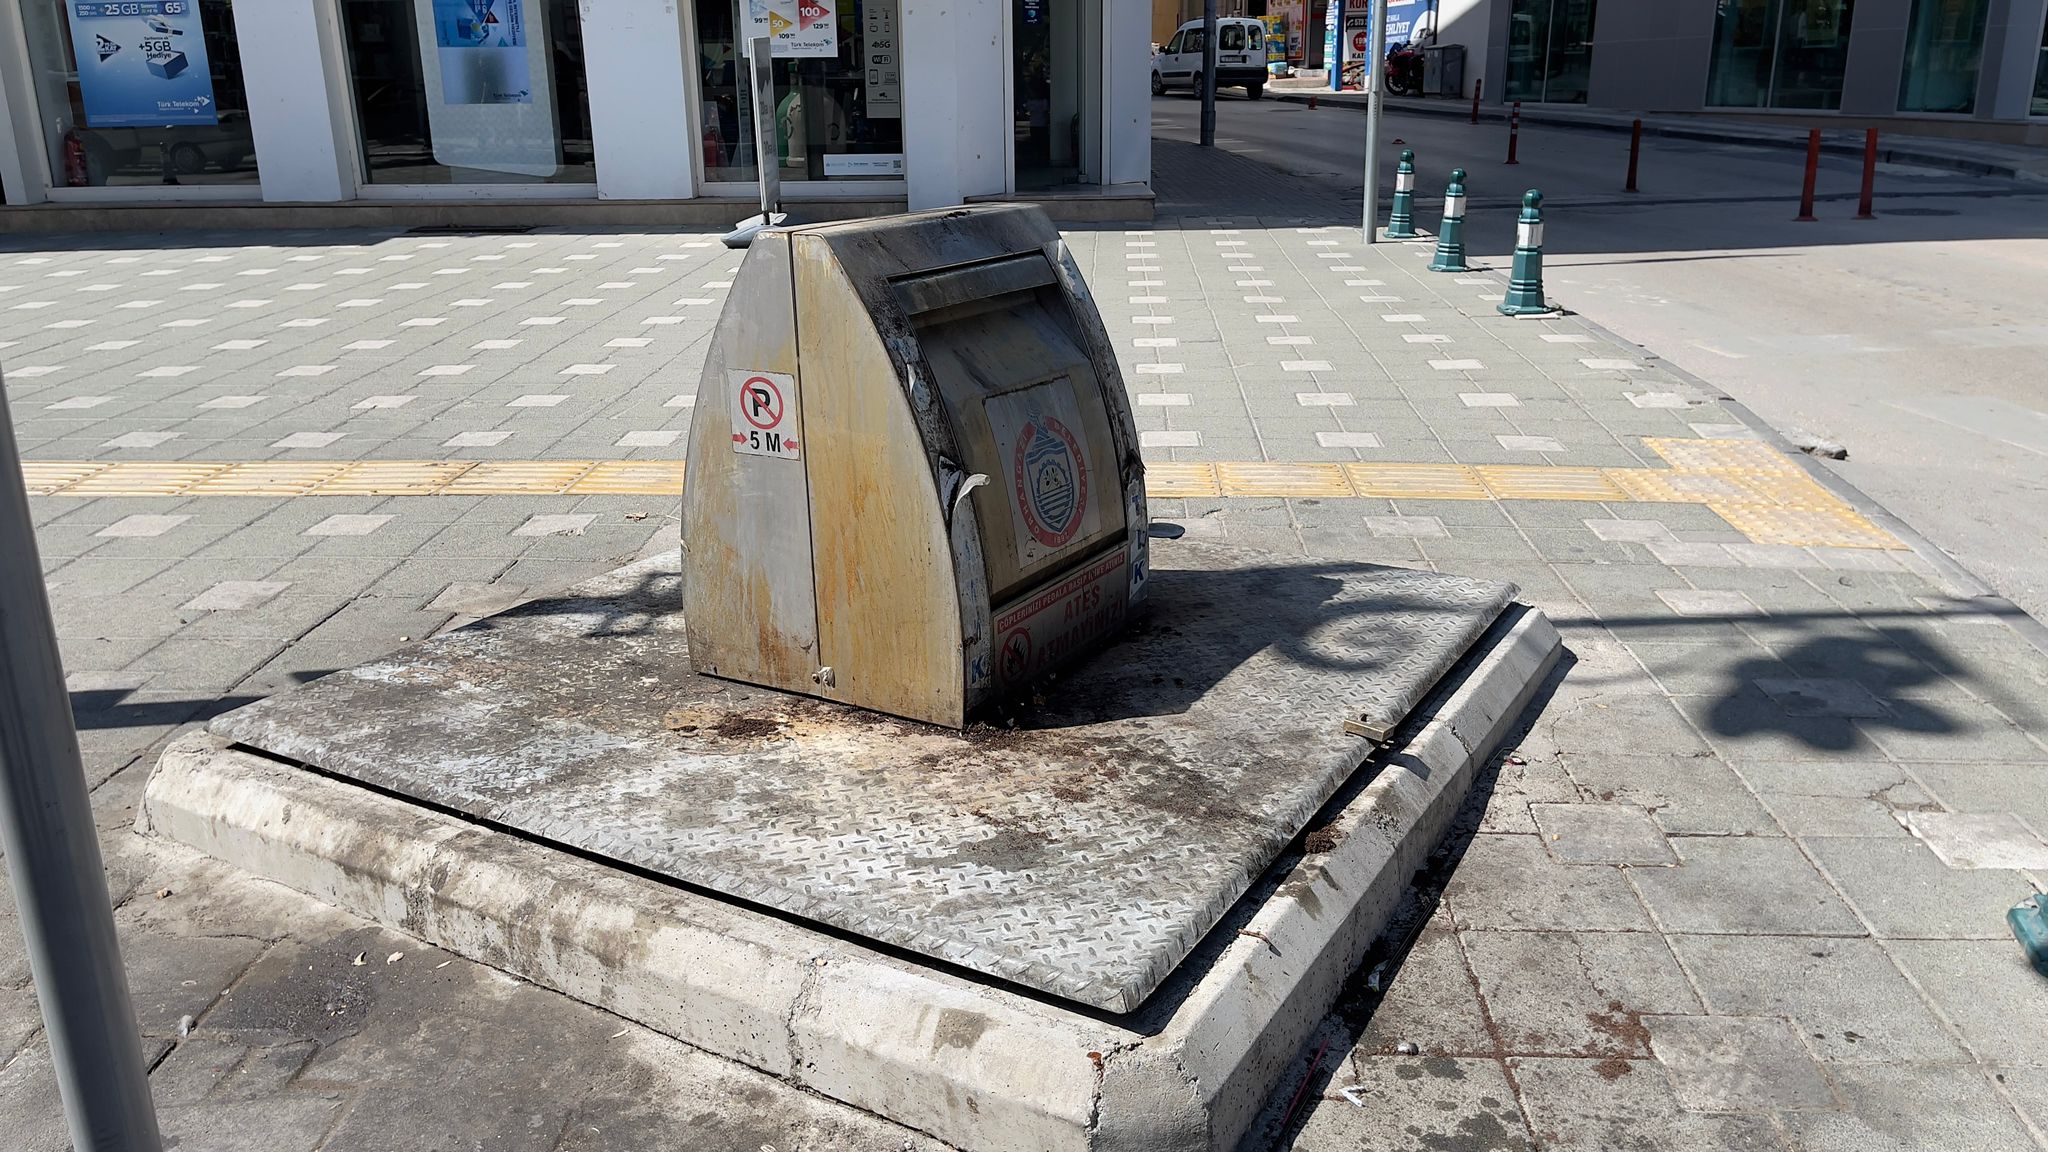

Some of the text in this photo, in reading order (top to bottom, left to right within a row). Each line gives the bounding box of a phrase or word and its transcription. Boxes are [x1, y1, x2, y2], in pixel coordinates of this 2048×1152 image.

[105, 4, 120, 15] 25
[121, 4, 139, 15] GB
[165, 3, 181, 13] 65
[800, 7, 820, 17] 100
[772, 20, 784, 28] 50
[153, 41, 171, 51] GB
[172, 100, 200, 108] Telekom
[750, 430, 781, 453] 5 M
